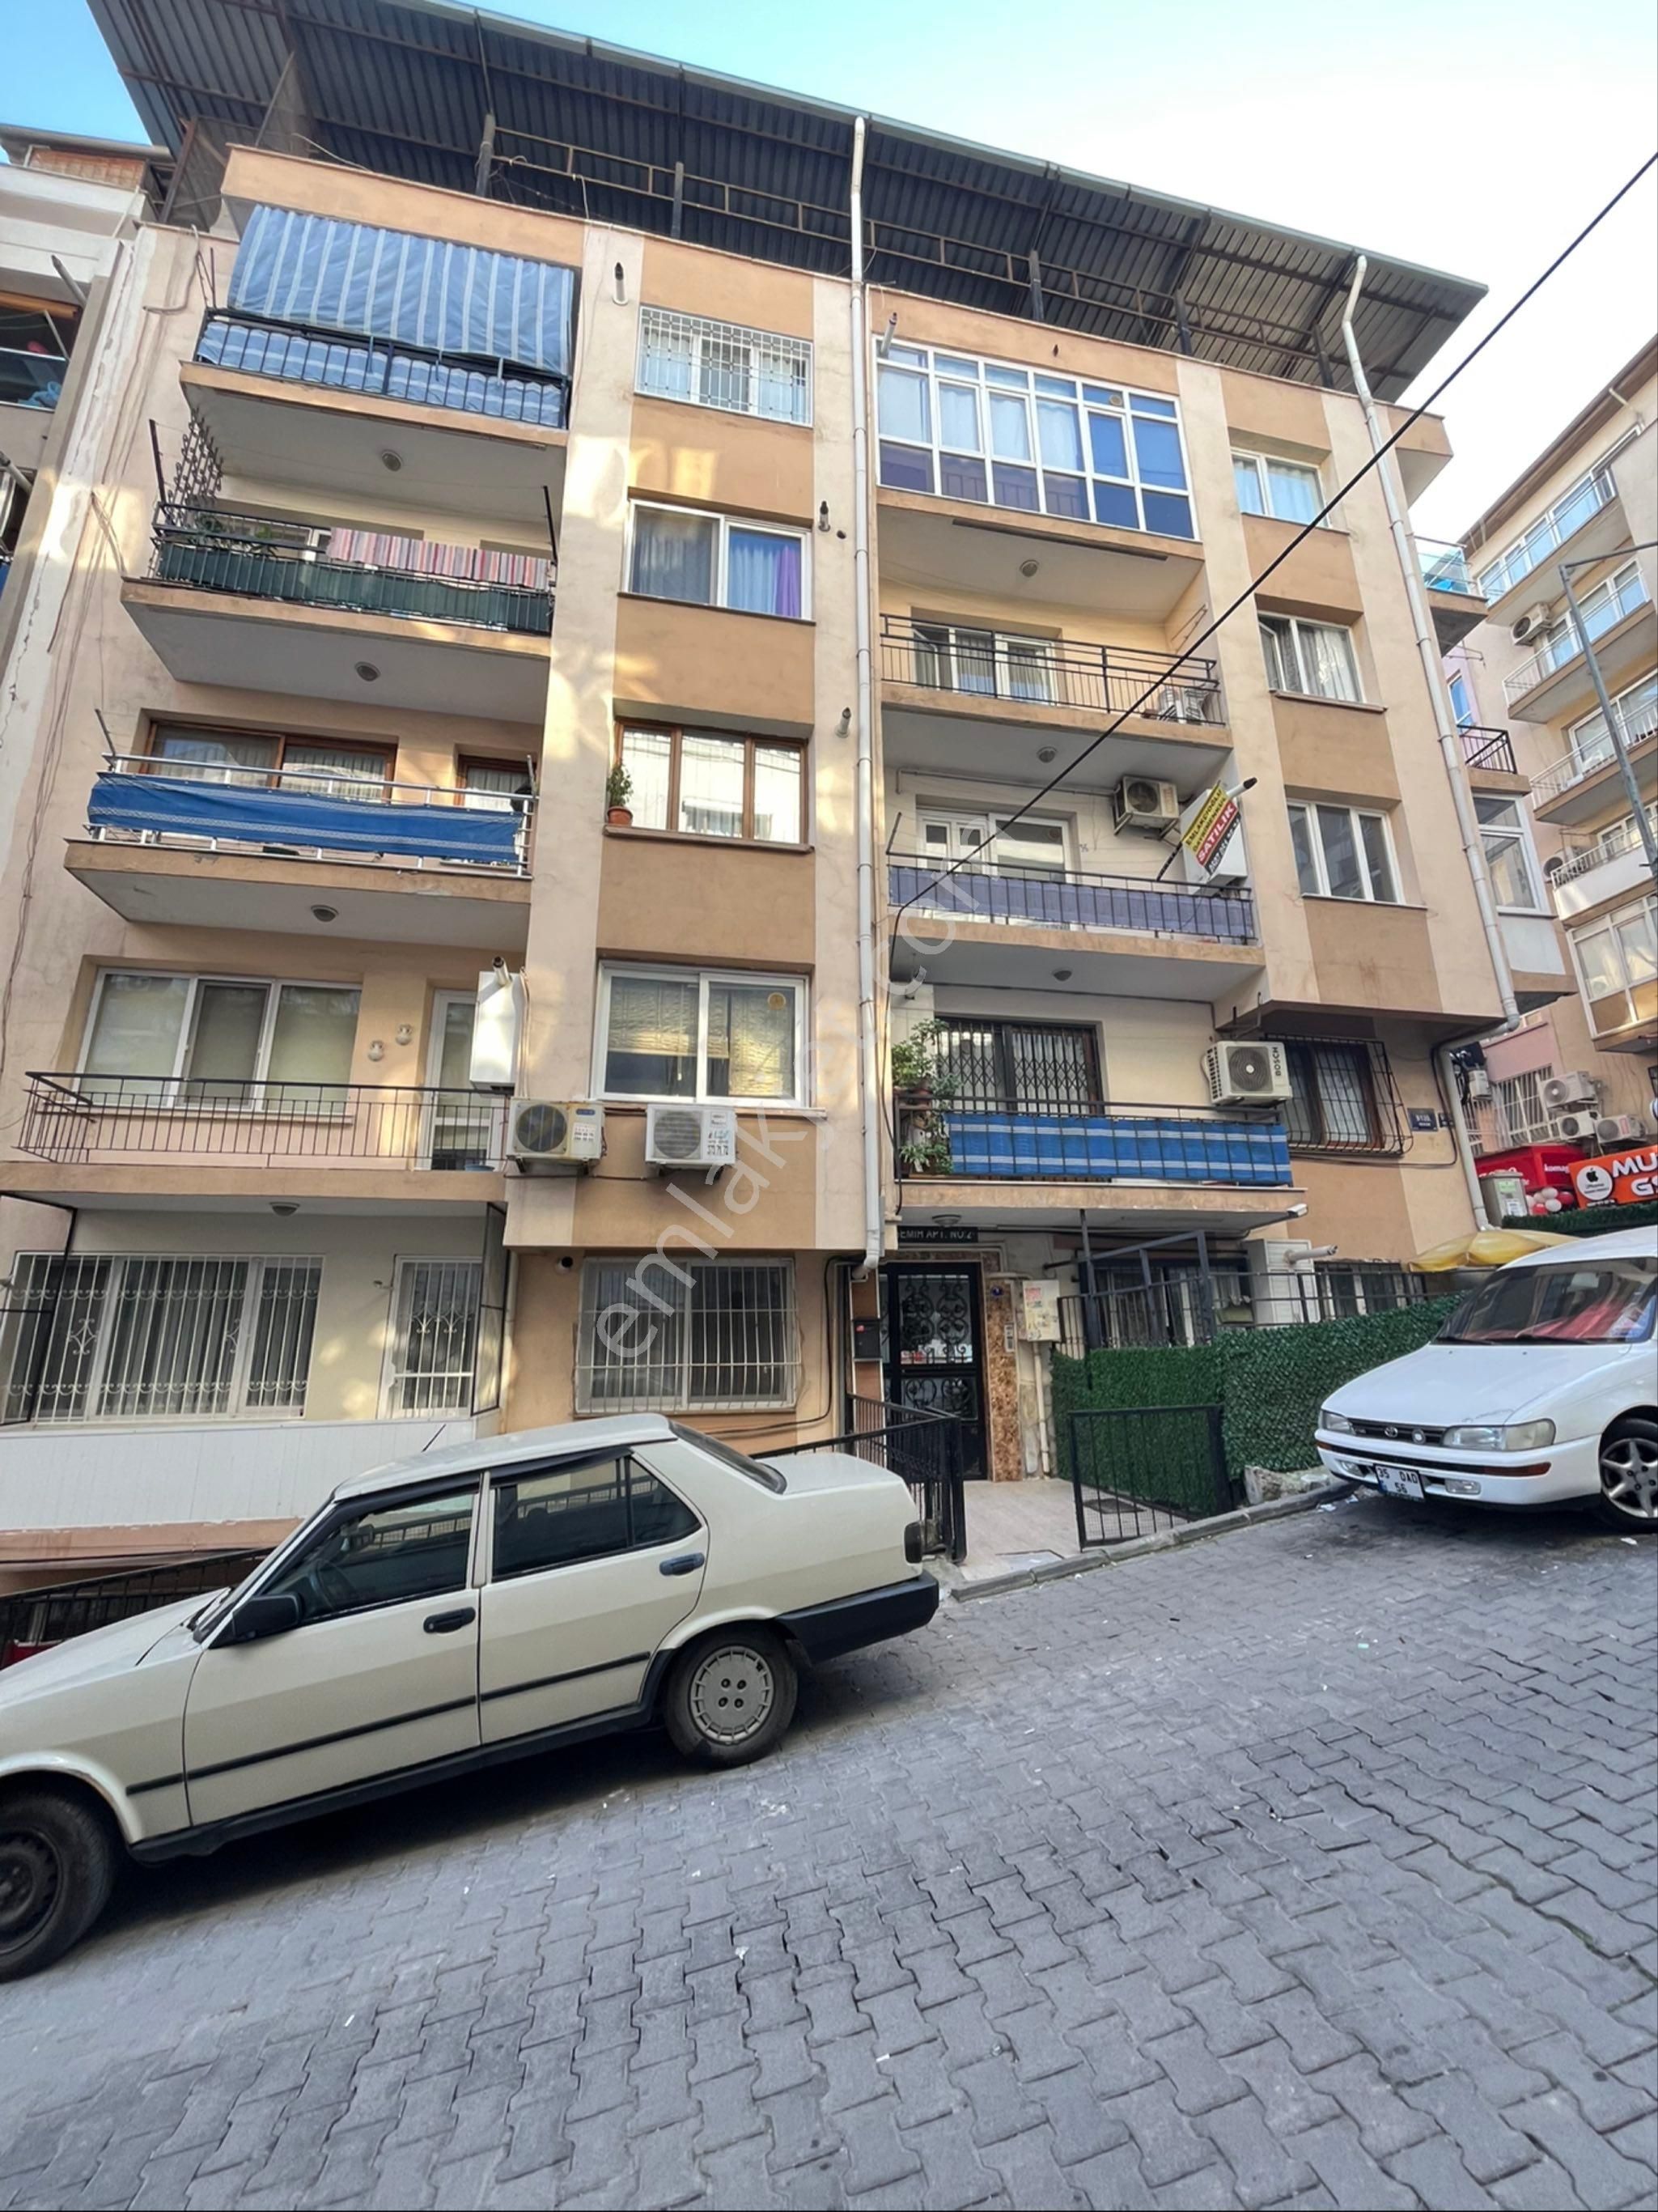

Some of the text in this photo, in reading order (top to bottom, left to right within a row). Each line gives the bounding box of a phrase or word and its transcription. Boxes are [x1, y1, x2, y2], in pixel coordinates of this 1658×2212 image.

[1198, 805, 1234, 862] SATILIK
[1271, 1047, 1282, 1076] BOSCH
[1378, 1468, 1389, 1479] 35
[1395, 1483, 1407, 1493] 56
